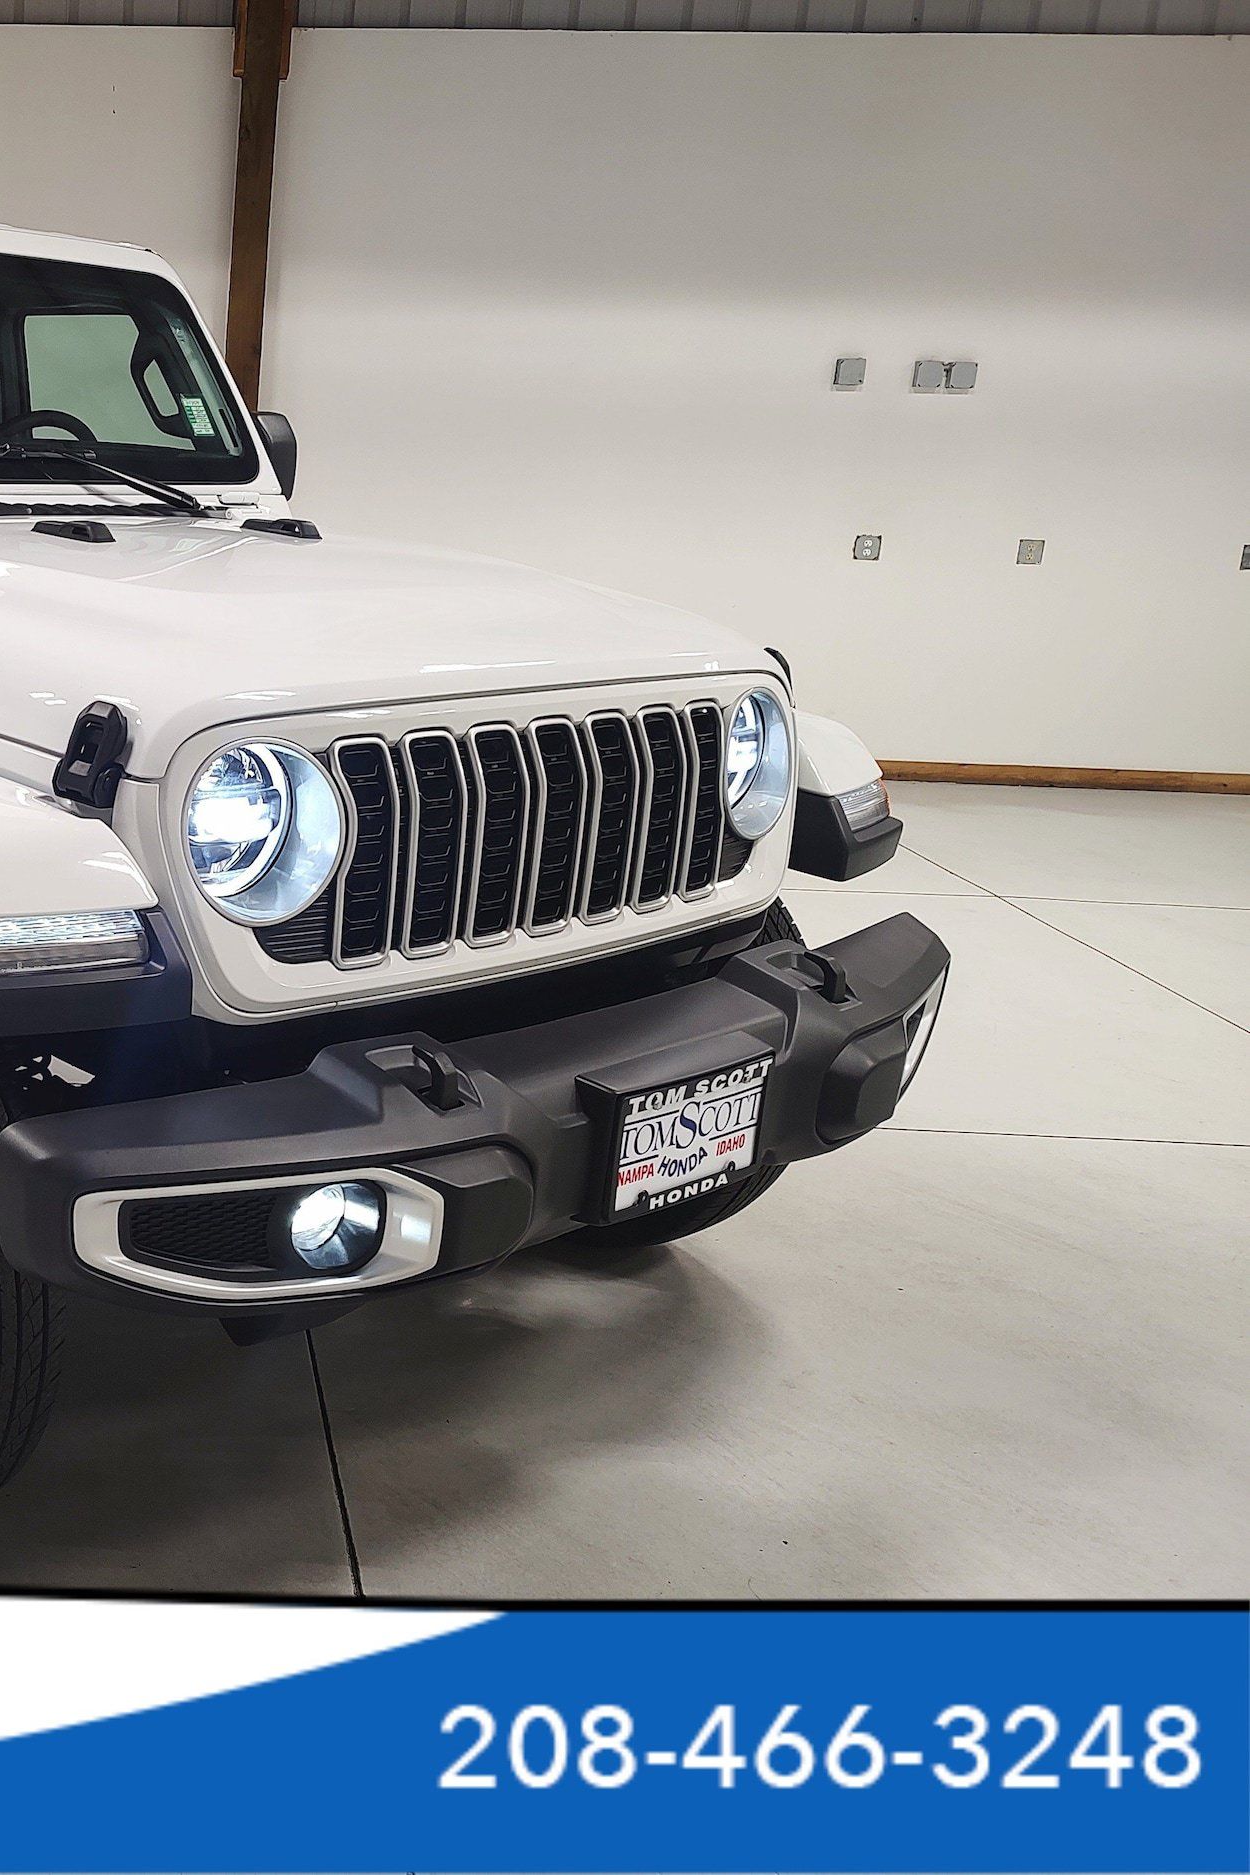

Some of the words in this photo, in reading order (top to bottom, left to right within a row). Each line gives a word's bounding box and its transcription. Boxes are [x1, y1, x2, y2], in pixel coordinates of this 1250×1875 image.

[626, 1085, 688, 1117] TOM
[695, 1058, 773, 1097] SCOTT
[618, 1162, 655, 1188] NAMPA
[658, 1147, 708, 1177] HONDA
[715, 1133, 746, 1157] IDAHO
[649, 1174, 728, 1210] HONDA
